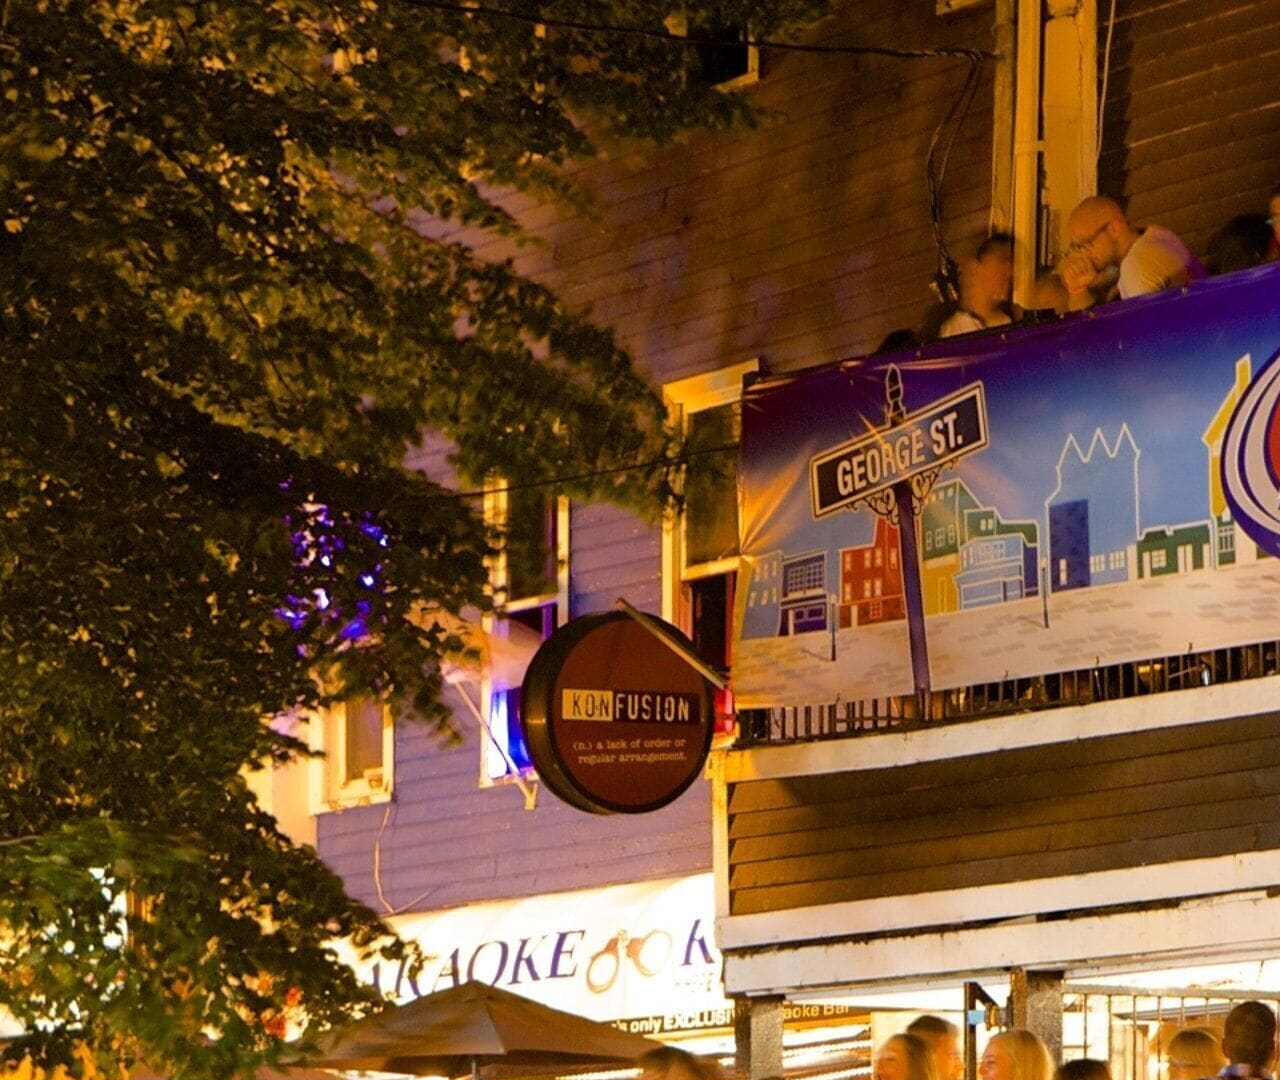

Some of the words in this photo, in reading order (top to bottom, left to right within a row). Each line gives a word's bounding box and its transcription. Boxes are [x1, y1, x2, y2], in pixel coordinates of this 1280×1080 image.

[836, 428, 926, 496] GEORGE
[930, 411, 963, 455] ST.
[607, 740, 626, 749] lack
[630, 738, 641, 748] of
[644, 738, 670, 748] order
[674, 738, 686, 747] or
[578, 754, 615, 765] regular
[630, 1016, 662, 1033] only
